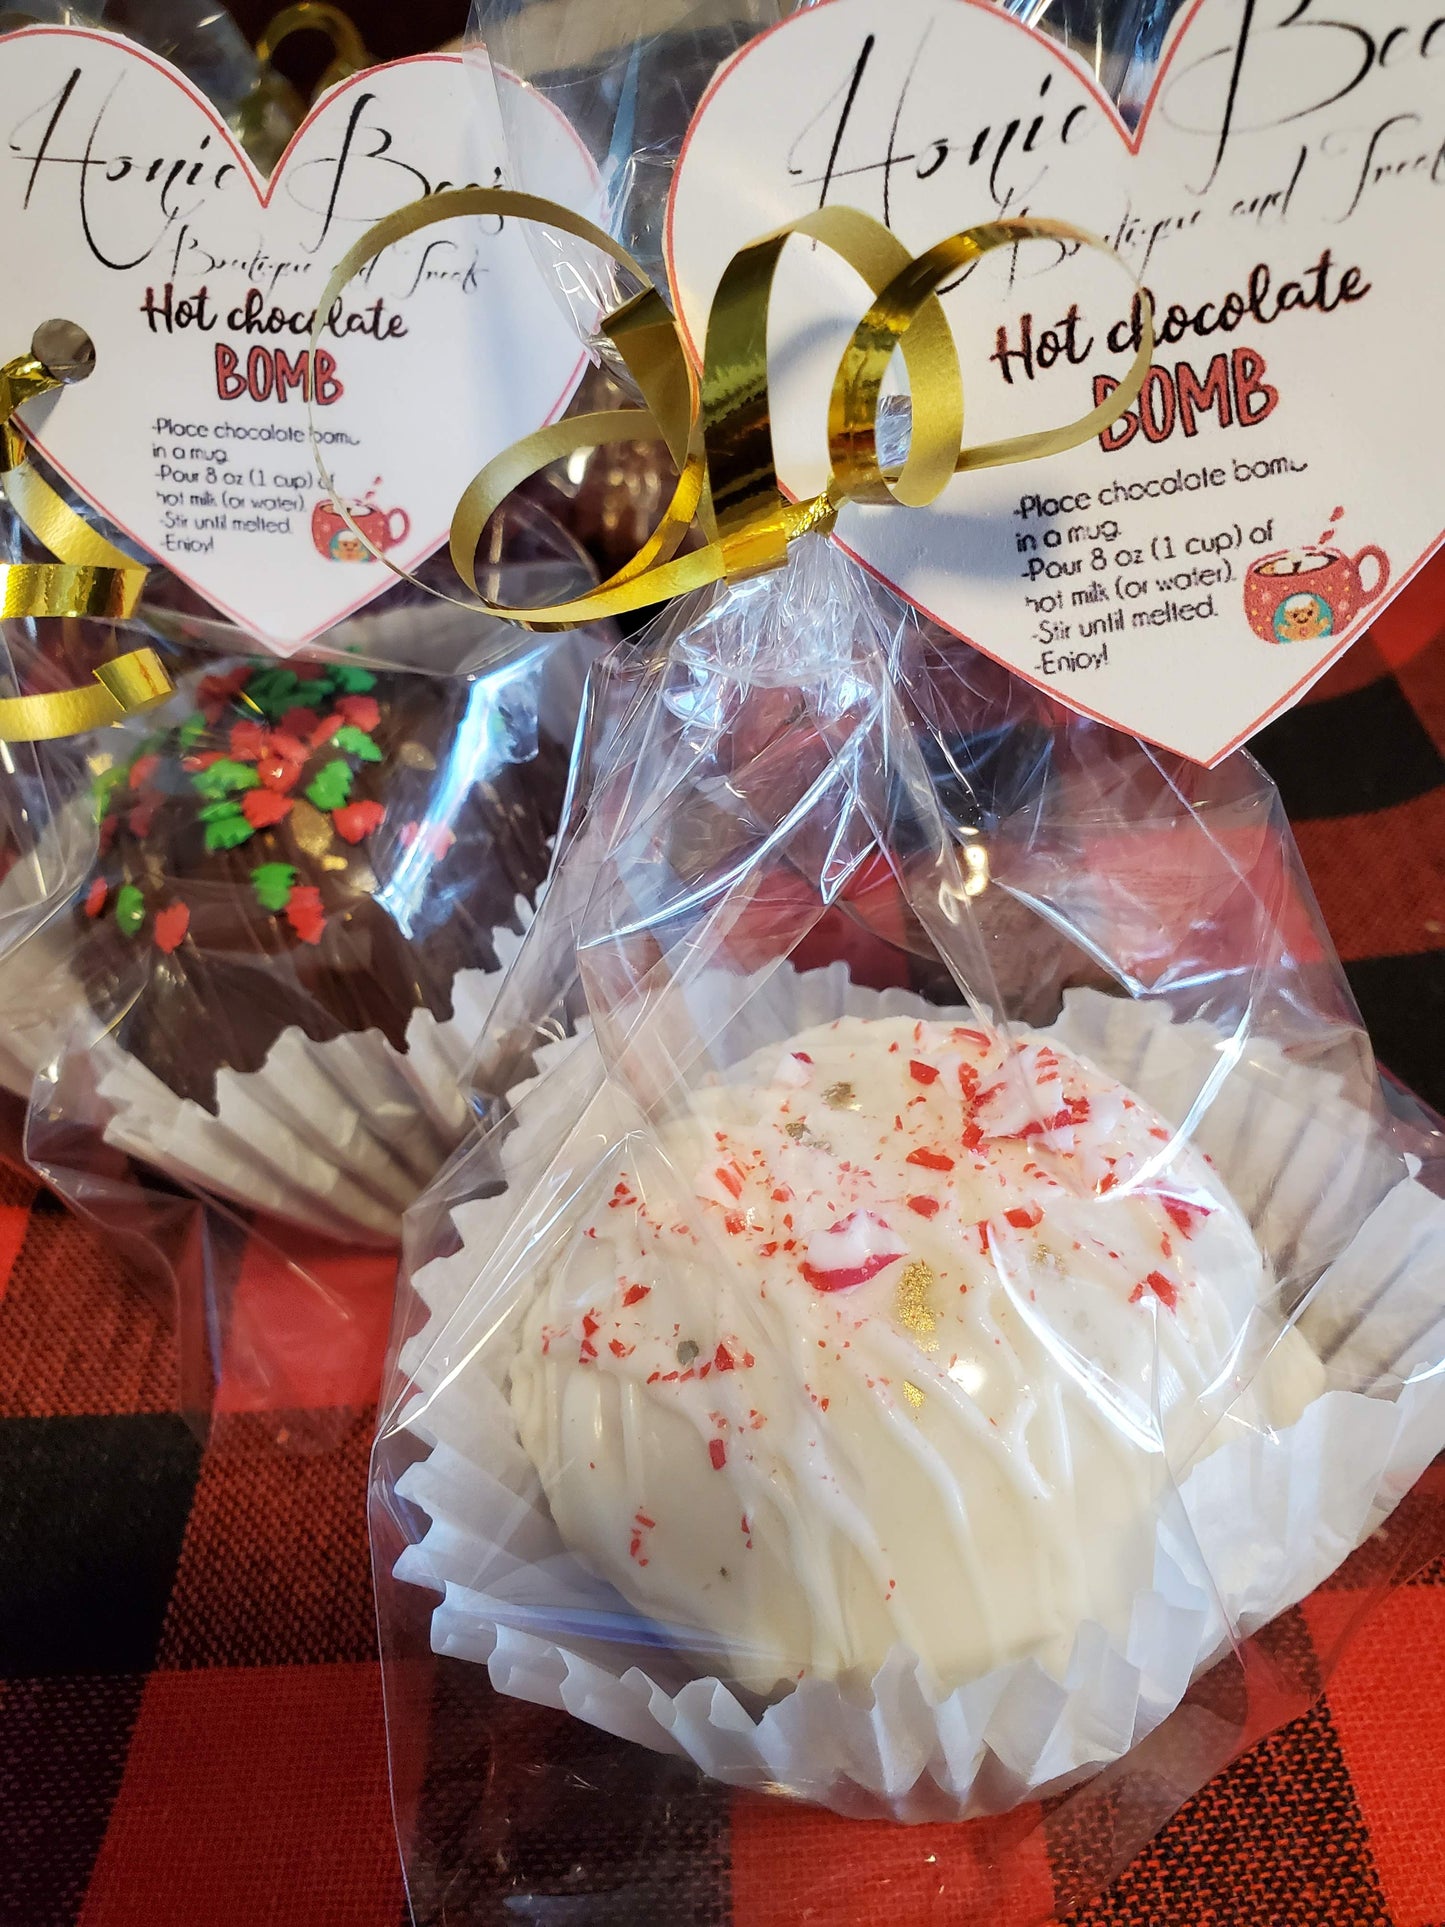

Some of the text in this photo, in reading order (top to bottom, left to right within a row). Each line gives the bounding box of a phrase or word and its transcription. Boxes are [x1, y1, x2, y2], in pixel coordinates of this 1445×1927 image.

[1001, 190, 1200, 300] Botique
[1229, 145, 1308, 226] and
[140, 283, 409, 340] Hot choclate
[990, 248, 1372, 384] Hot chocolate
[214, 342, 344, 405] BOMB
[1092, 346, 1279, 452] BOMB
[151, 417, 361, 446] -Place chocolate bom
[152, 442, 167, 459] in
[172, 445, 186, 460] a
[155, 464, 199, 483] -Pour
[206, 467, 218, 484] 8
[223, 473, 243, 485] oz
[249, 468, 265, 487] (1
[273, 471, 313, 491] cup)
[1013, 493, 1091, 519] -Place
[1098, 468, 1226, 506] chocolate
[190, 490, 217, 507] milk
[222, 490, 245, 508] (or
[160, 511, 188, 528] -Stir
[194, 514, 227, 531] until
[160, 534, 215, 554] -Enjoy!
[1015, 532, 1036, 552] in
[1043, 529, 1062, 548] a
[1021, 518, 1275, 582] -Pour 8 oz (1 cup) of
[1072, 580, 1110, 607] milk
[1115, 575, 1148, 600] (or
[1031, 594, 1218, 645] -Stir until melted.
[1034, 643, 1109, 675] -Enjoy!
